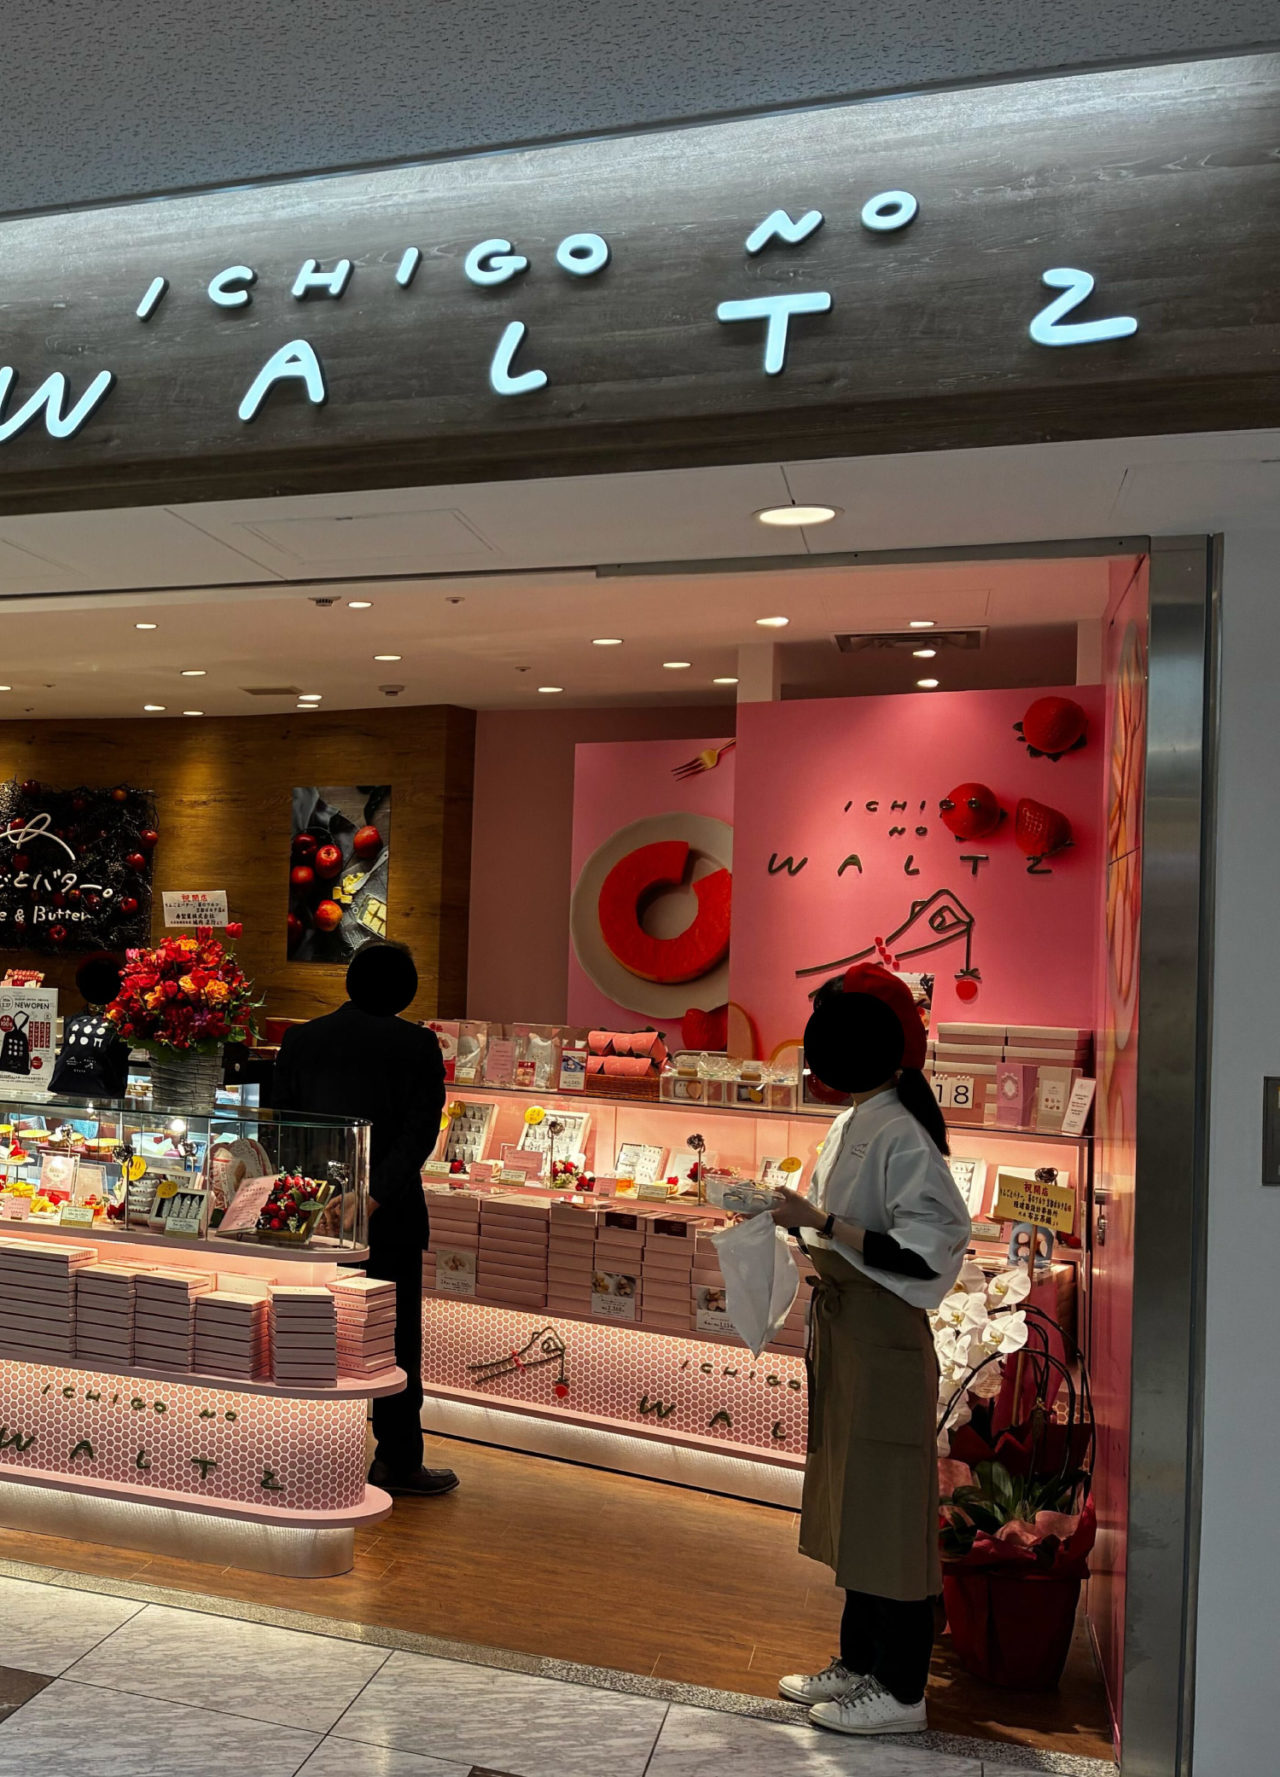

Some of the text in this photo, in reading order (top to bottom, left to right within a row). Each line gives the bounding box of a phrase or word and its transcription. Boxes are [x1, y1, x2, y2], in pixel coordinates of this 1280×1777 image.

[137, 190, 919, 320] ICHIGO NO
[889, 826, 928, 837] NO
[768, 853, 1053, 876] WALTZ
[14, 908, 25, 923] &
[33, 905, 92, 924] Butter
[14, 1001, 30, 1009] NEW
[31, 1002, 50, 1010] OPEN
[681, 1359, 802, 1392] ICHIGO
[42, 1382, 238, 1422] ICHIGO NO
[639, 1395, 788, 1440] WAL
